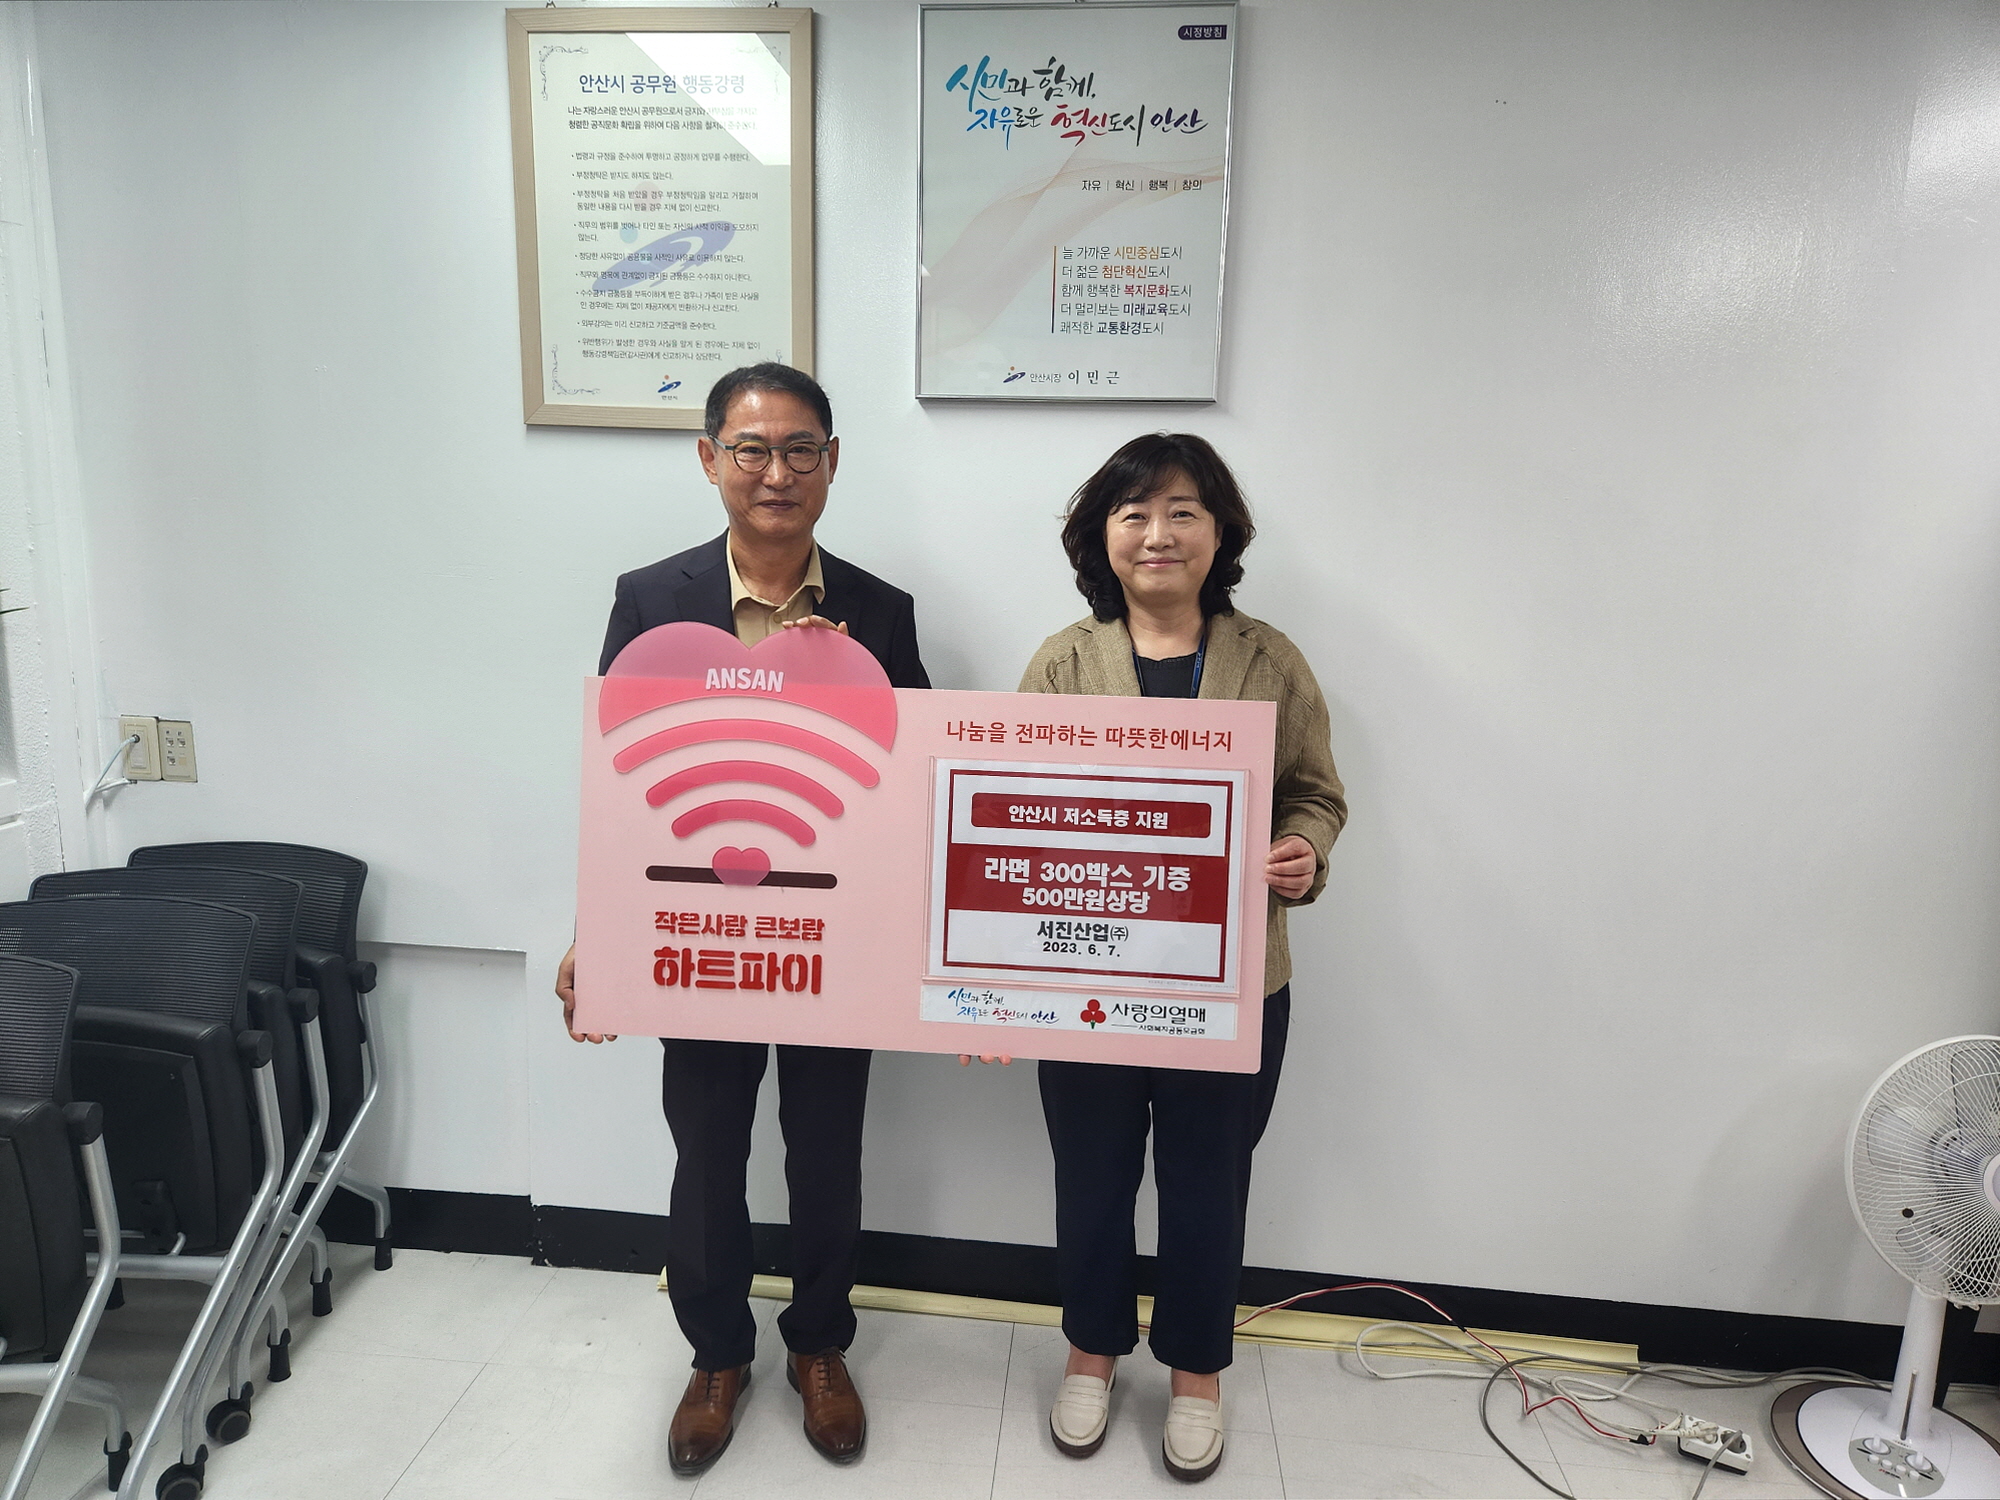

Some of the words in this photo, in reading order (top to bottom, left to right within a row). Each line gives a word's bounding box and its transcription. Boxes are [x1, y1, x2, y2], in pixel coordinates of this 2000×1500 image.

[1183, 26, 1223, 38] 시정방침
[579, 74, 625, 94] 안산시
[630, 74, 677, 94] 공무원
[683, 74, 744, 94] 행동강령
[946, 55, 1035, 112] 시민과
[568, 106, 582, 116] 나는
[584, 106, 618, 116] 자랑스러운
[620, 106, 640, 116] 안산시
[642, 106, 683, 116] 공무원으로서
[569, 120, 588, 130] 청렴한
[591, 120, 618, 130] 공직문화
[621, 120, 641, 130] 확립을
[644, 120, 664, 130] 위하여
[666, 120, 680, 130] 다음
[682, 120, 702, 130] 사항을
[966, 106, 1044, 150] 자유로운
[1050, 104, 1145, 147] 혁신도시
[1150, 107, 1209, 134] 안산
[576, 152, 594, 160] 법령과
[597, 152, 616, 161] 규정을
[618, 152, 644, 161] 준수하여
[646, 152, 671, 161] 투명하고
[674, 152, 700, 161] 공정하게
[702, 153, 720, 161] 업무를
[723, 153, 750, 161] 수행한다.
[576, 171, 608, 180] 부정청탁은
[610, 171, 629, 180] 받지도
[632, 171, 650, 180] 하지도
[652, 171, 674, 180] 않는다.
[1082, 180, 1102, 191] 자유
[1115, 180, 1135, 191] 혁신
[1148, 180, 1168, 191] 행복
[1182, 180, 1202, 191] 창의
[577, 202, 596, 211] 동일한
[598, 202, 616, 211] 내용을
[619, 203, 632, 211] 다시
[634, 203, 646, 212] 받을
[650, 203, 662, 212] 경우
[664, 203, 676, 212] 지체
[679, 203, 692, 212] 없이
[694, 203, 720, 212] 신고한다.
[1062, 247, 1074, 259] 늘
[1076, 246, 1111, 259] 가까운
[1114, 246, 1183, 260] 시민중심도시
[1062, 266, 1072, 278] 더
[1076, 266, 1099, 279] 젊은
[1102, 266, 1170, 278] 첨단혁신도시
[1061, 284, 1084, 297] 함께
[1086, 284, 1121, 298] 행복한
[1124, 284, 1192, 298] 복지문화도시
[1060, 304, 1071, 316] 더
[1075, 304, 1120, 316] 멀리보는
[1123, 304, 1191, 316] 미래교육도시
[1060, 322, 1094, 335] 쾌적한
[1096, 322, 1164, 335] 교통환경도시
[1030, 372, 1062, 384] 안산시장
[705, 668, 784, 693] ANSAN
[947, 720, 1008, 743] 나눔을
[1016, 723, 1098, 747] 전파하는
[1105, 727, 1232, 752] 따뜻한에너지
[1008, 805, 1056, 824] 안산시
[1063, 808, 1130, 828] 저소득층
[1135, 812, 1168, 830] 지원
[985, 857, 1030, 883] 라면
[1040, 862, 1132, 888] 300박스
[1143, 865, 1192, 892] 기증
[1022, 887, 1150, 914] 500만원상당
[654, 911, 748, 938] 작은사랑
[755, 916, 825, 942] 큰보람
[1042, 942, 1082, 956] 2023.
[653, 946, 822, 995] 하트파이
[1031, 1010, 1060, 1024] 안산
[1111, 1003, 1206, 1025] 사랑의열매
[1138, 1024, 1206, 1036] 사회복지공동모금회
